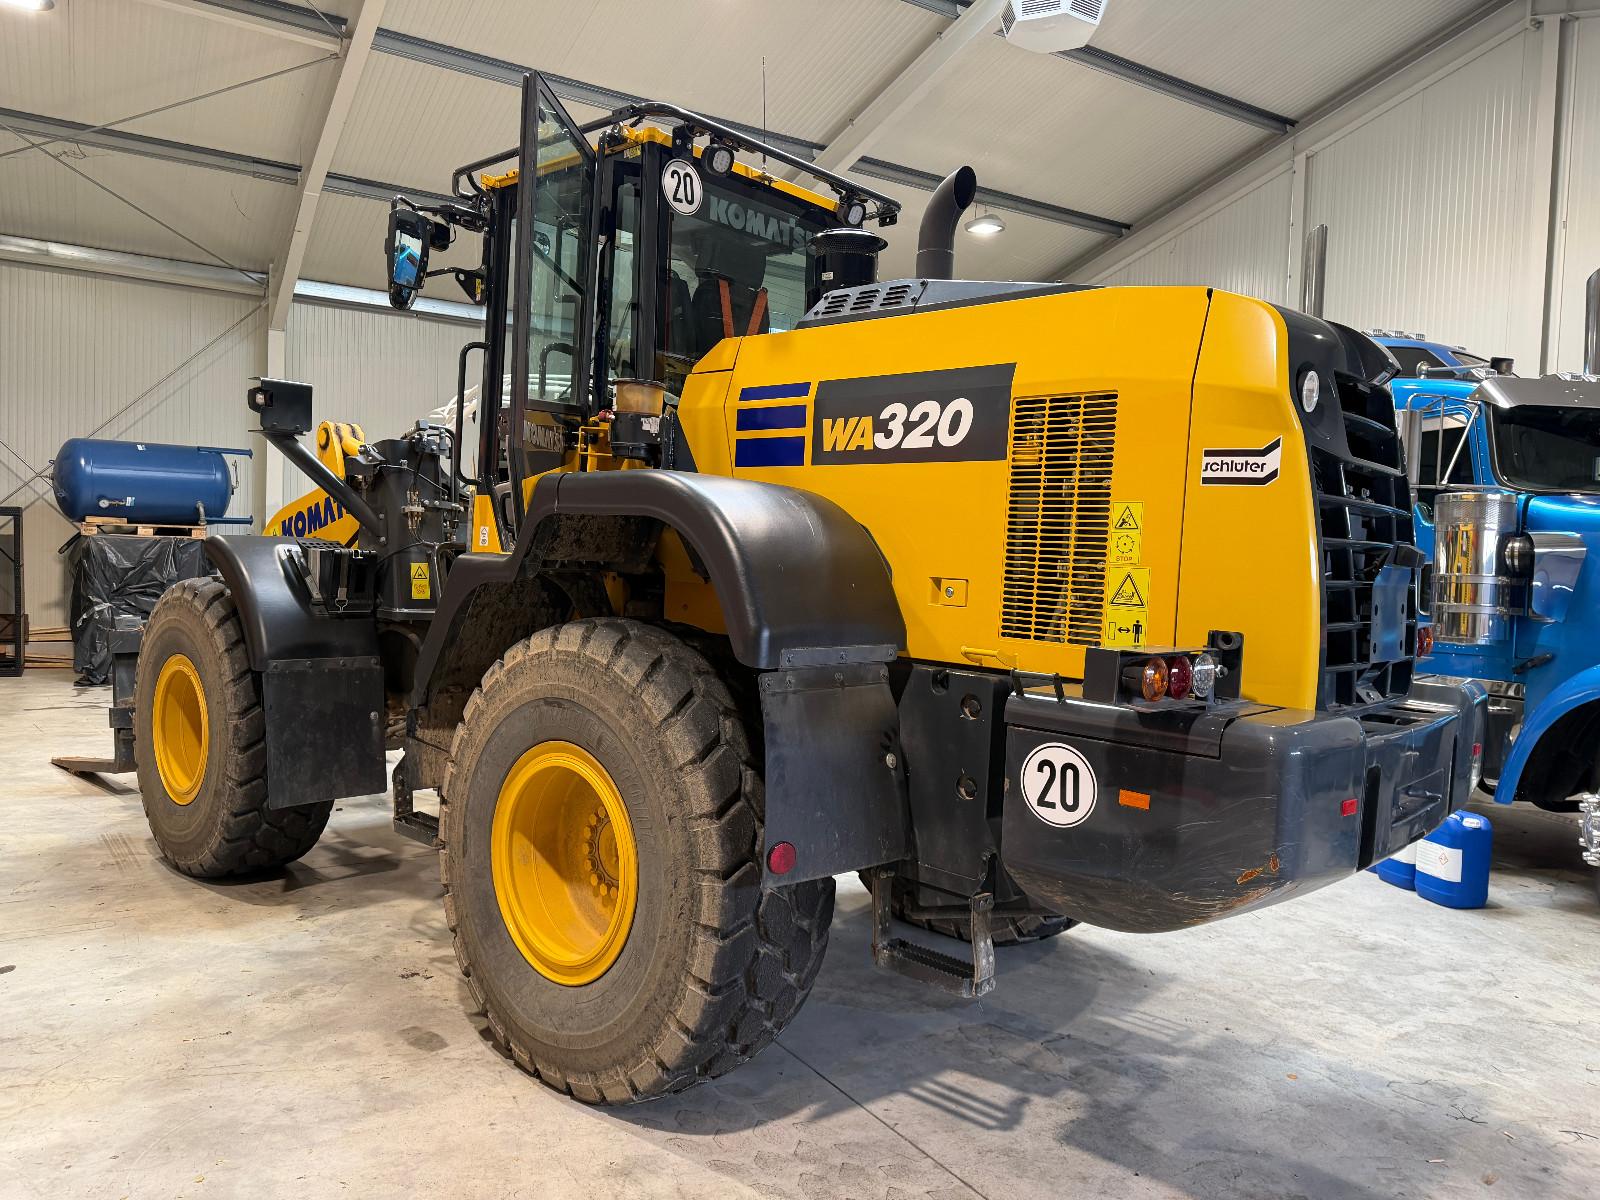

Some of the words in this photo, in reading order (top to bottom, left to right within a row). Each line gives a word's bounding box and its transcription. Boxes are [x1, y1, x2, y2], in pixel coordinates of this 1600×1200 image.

[670, 169, 695, 206] 20
[822, 397, 974, 451] WA320
[1036, 758, 1080, 813] 20
